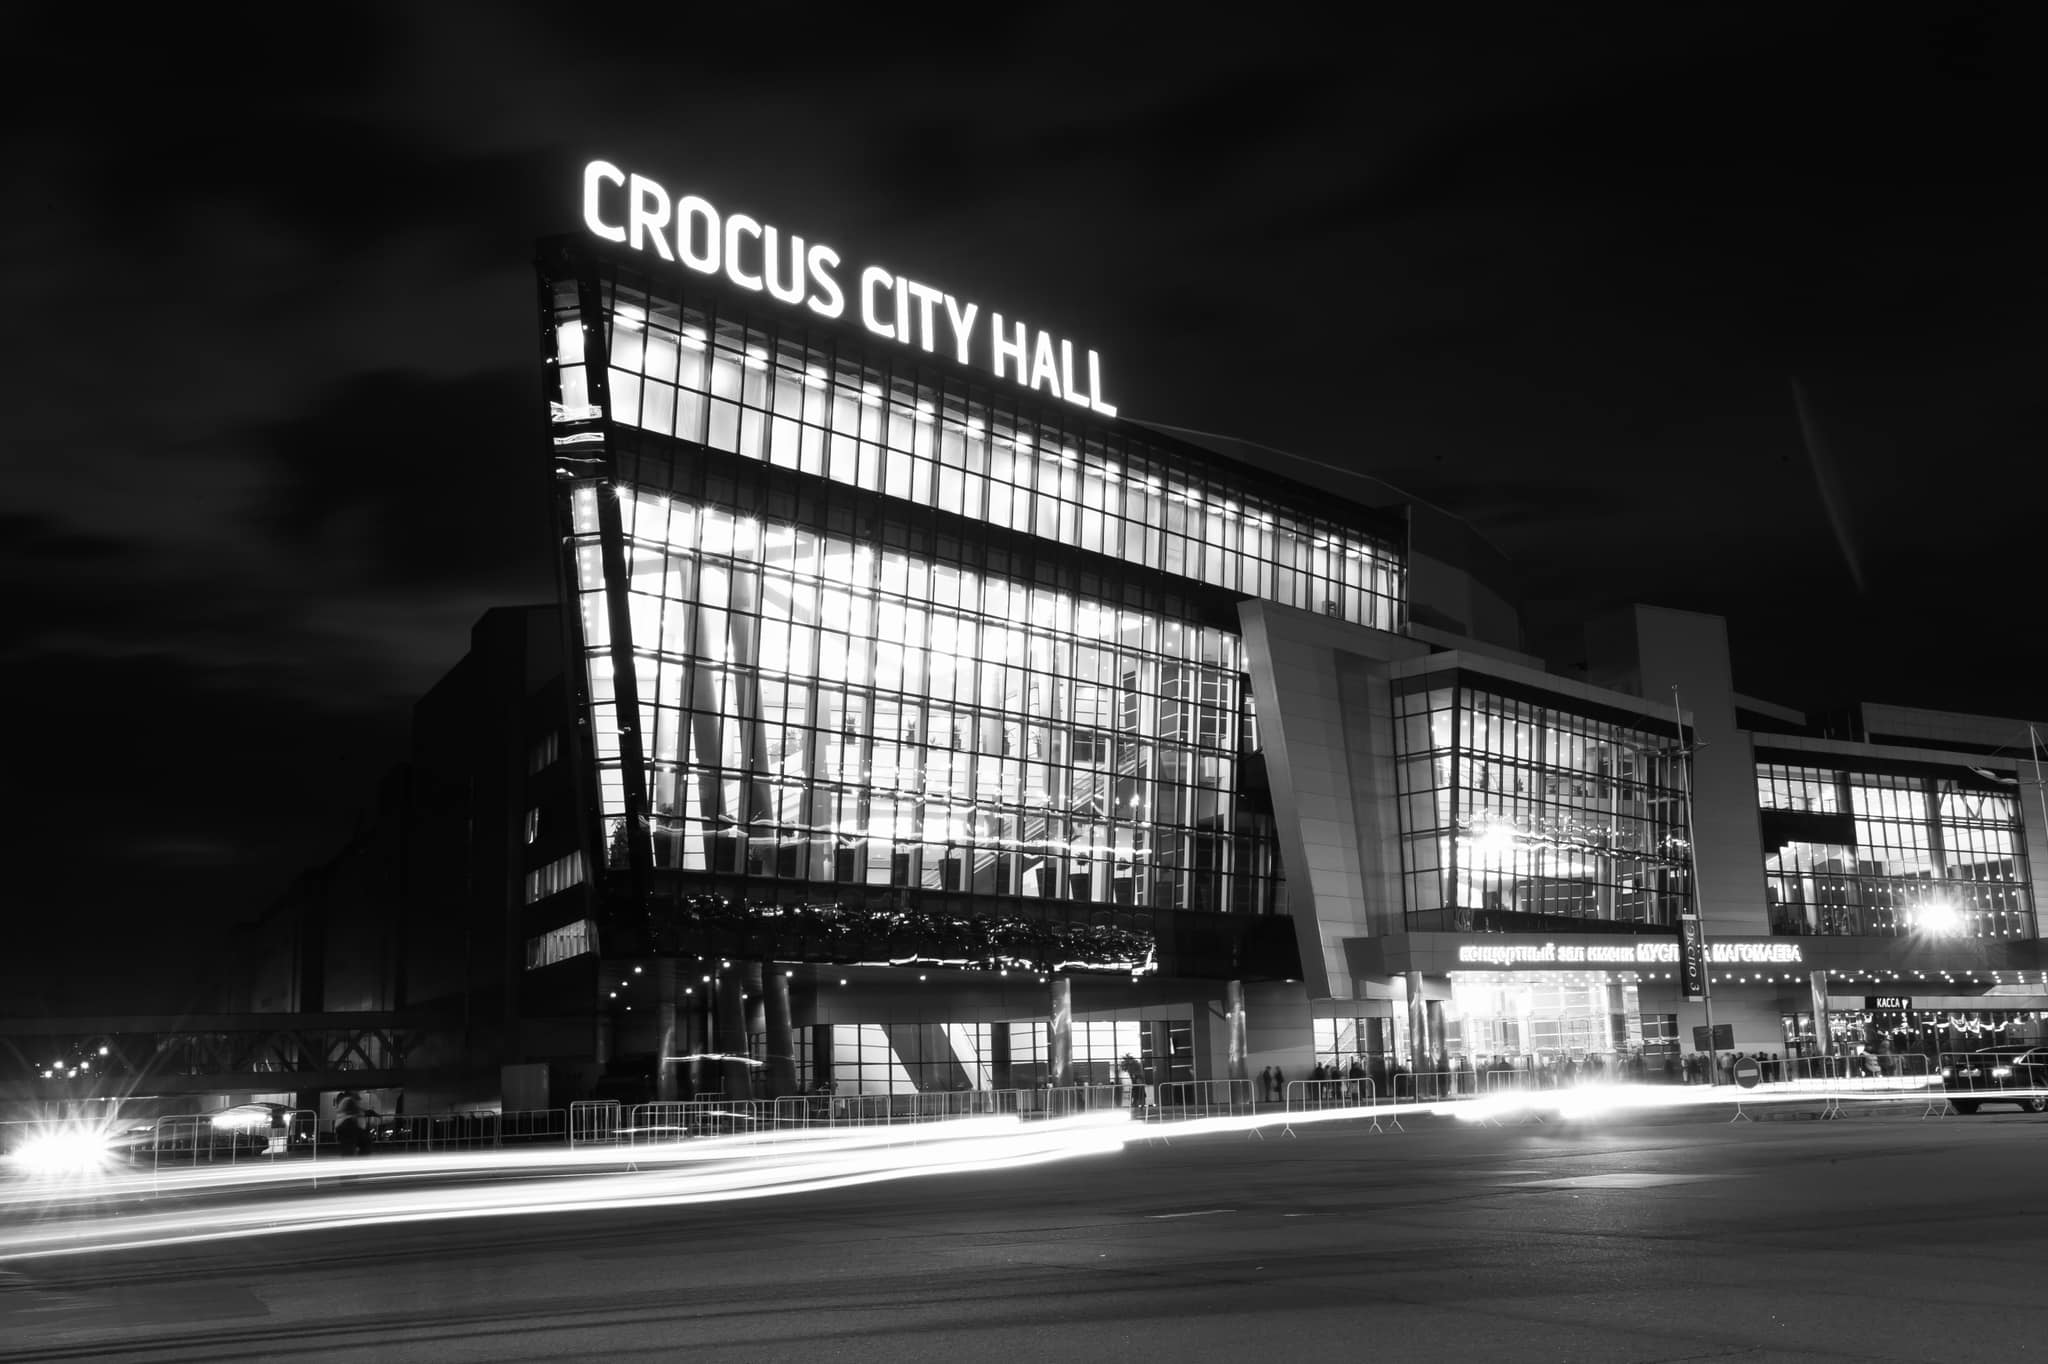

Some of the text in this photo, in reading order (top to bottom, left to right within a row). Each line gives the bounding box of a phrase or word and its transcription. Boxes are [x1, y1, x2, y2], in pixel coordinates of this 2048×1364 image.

[583, 159, 1118, 418] CROCUS CITY HALL
[1712, 943, 1802, 962] МАГОМАЕВА
[1876, 997, 1900, 1008] КАССА
